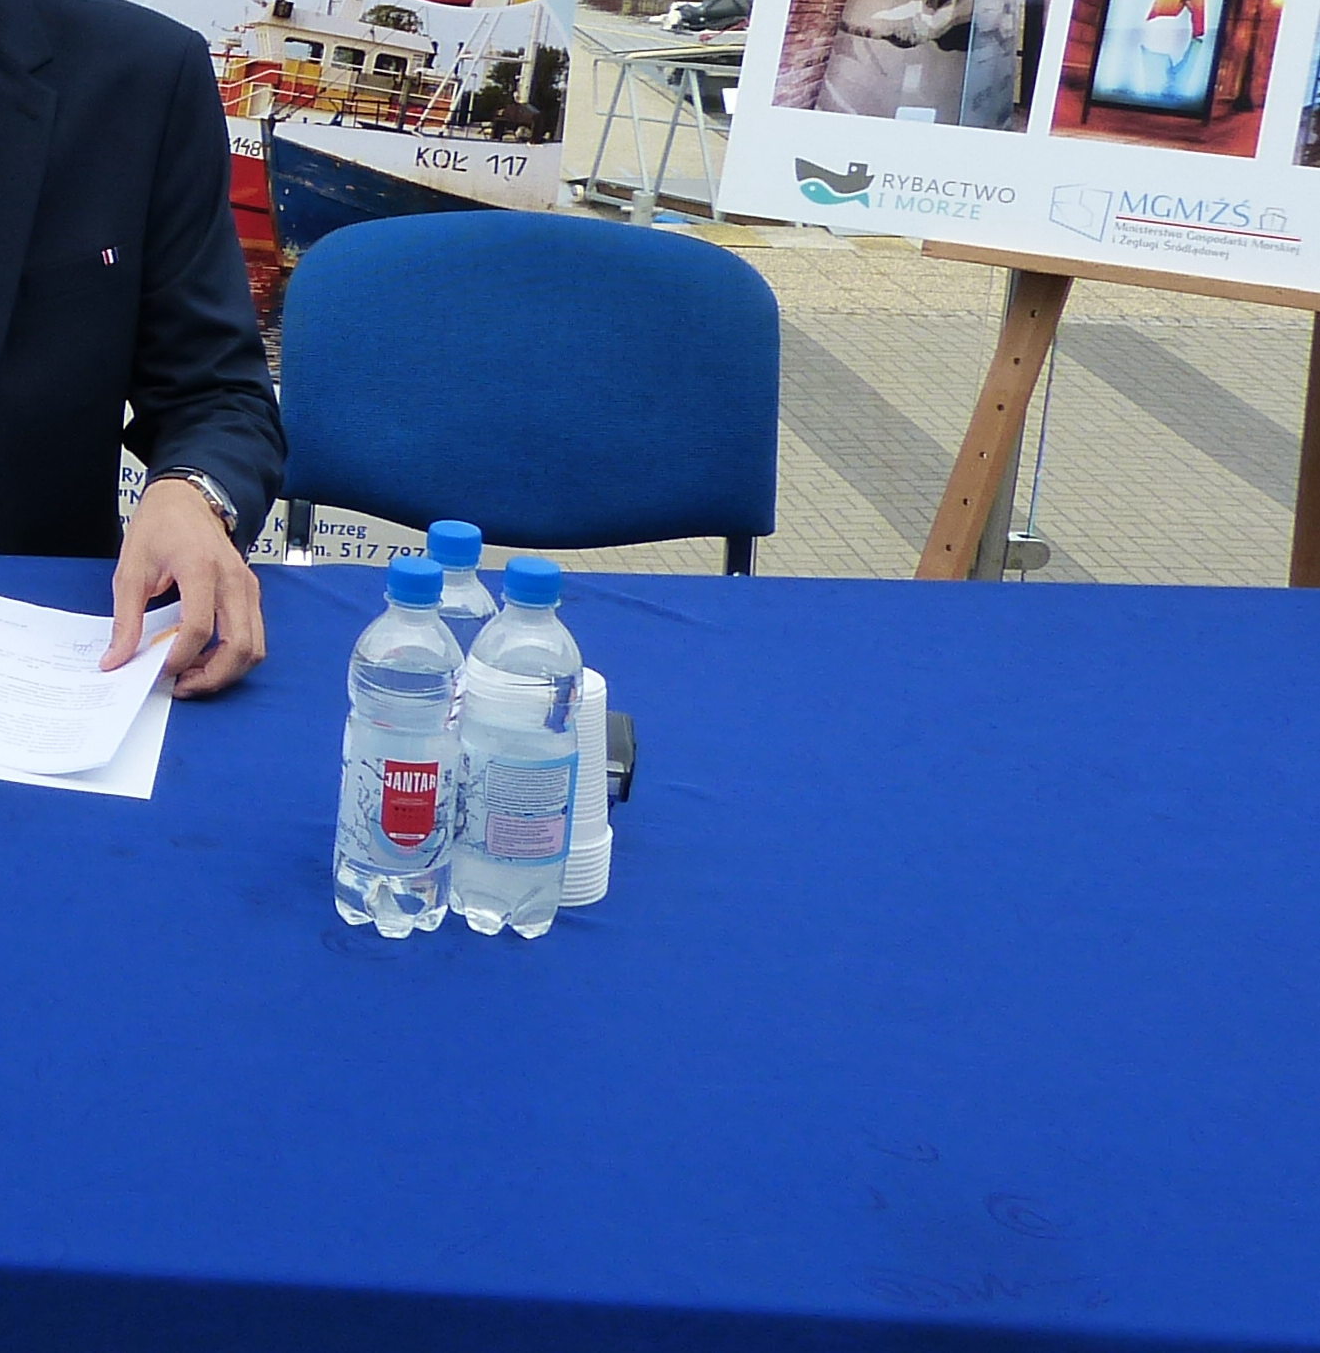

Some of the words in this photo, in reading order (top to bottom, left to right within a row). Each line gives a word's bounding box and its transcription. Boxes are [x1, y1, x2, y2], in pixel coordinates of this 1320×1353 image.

[232, 137, 262, 157] 148
[416, 146, 469, 172] KOŁ
[486, 154, 528, 177] 117
[882, 173, 1016, 204] RYBACTWO
[876, 191, 885, 208] I
[894, 194, 982, 220] MORZE
[274, 517, 367, 540] Kbrzeg
[340, 542, 379, 559] 517
[385, 771, 436, 793] JANTAR
